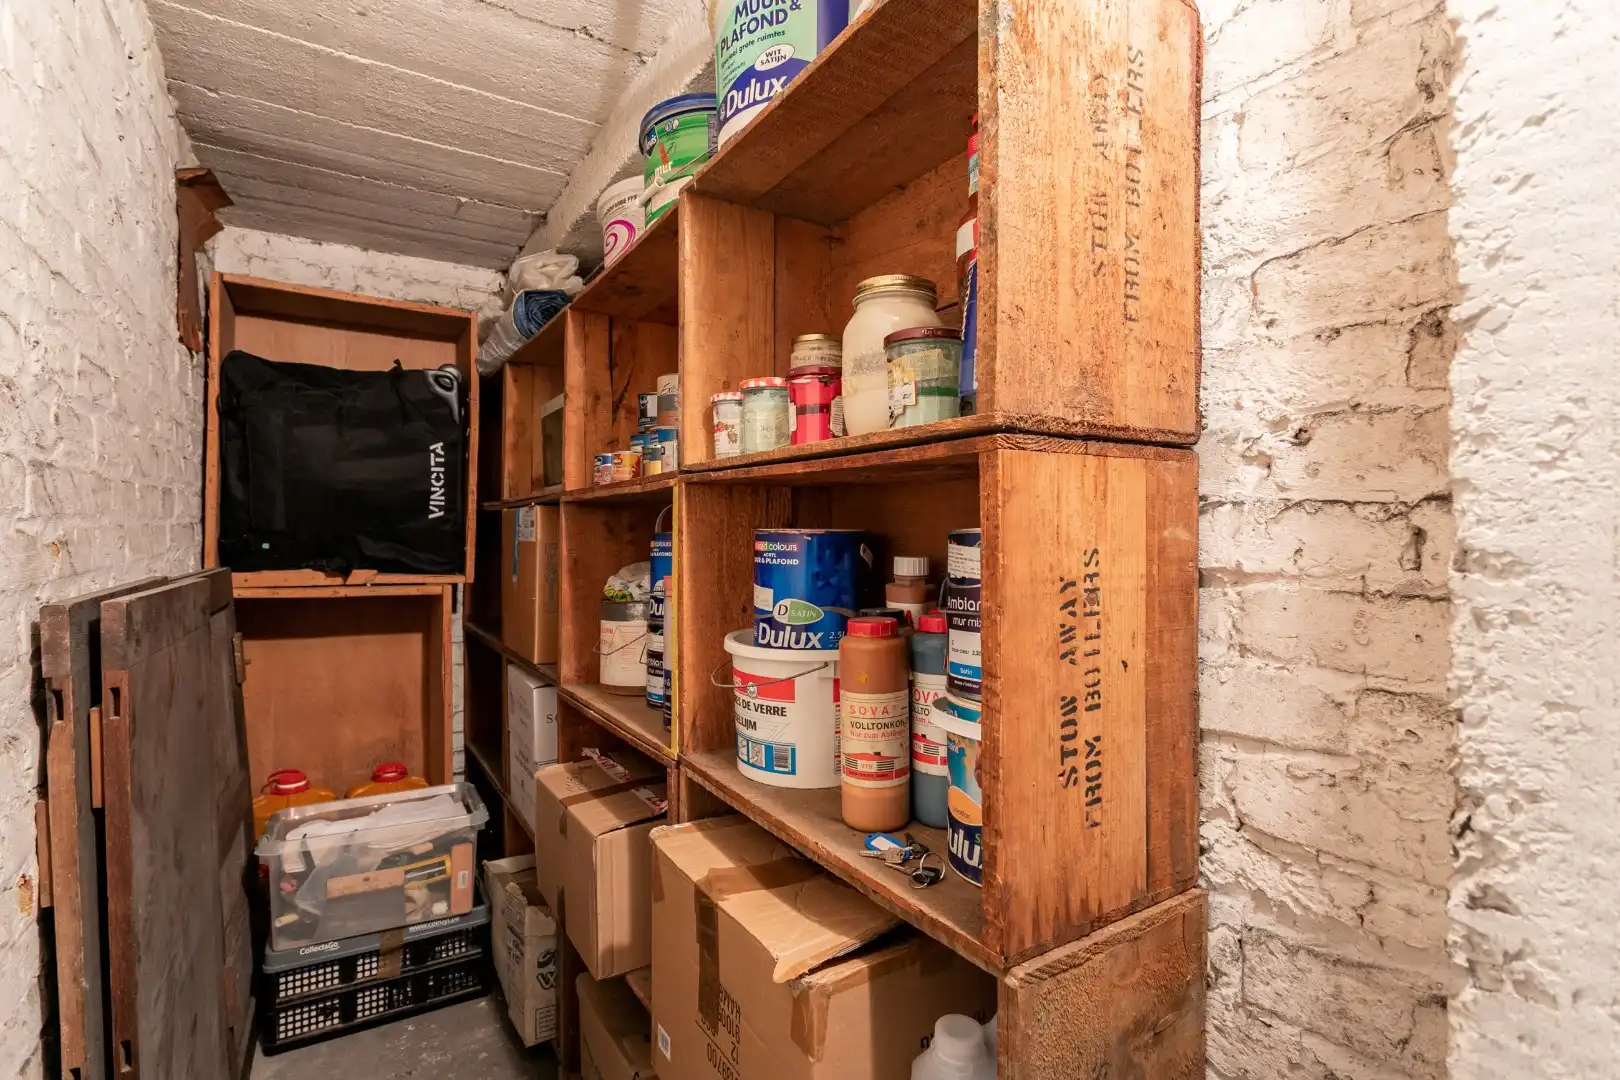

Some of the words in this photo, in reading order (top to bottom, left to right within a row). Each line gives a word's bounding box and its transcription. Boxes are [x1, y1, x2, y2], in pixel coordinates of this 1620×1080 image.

[720, 8, 788, 58] PLAFOND
[757, 30, 786, 42] ruimtes
[760, 54, 787, 66] SATIJN
[765, 49, 782, 58] WIT
[726, 76, 788, 119] Dulux
[428, 442, 445, 519] VINCITA
[769, 542, 798, 551] colours
[765, 557, 799, 565] PLAFOND
[790, 609, 817, 618] SATIN
[1059, 576, 1077, 665] AWAY
[758, 622, 824, 649] Dulux
[1083, 548, 1101, 712] BOILERS
[960, 667, 973, 676] Satin
[914, 688, 940, 704] OVA
[742, 698, 752, 711] DE
[753, 702, 787, 717] VERRE
[849, 704, 889, 716] SOVA
[1057, 695, 1078, 789] STOW
[1084, 735, 1102, 829] FROM
[948, 827, 982, 870] ulu
